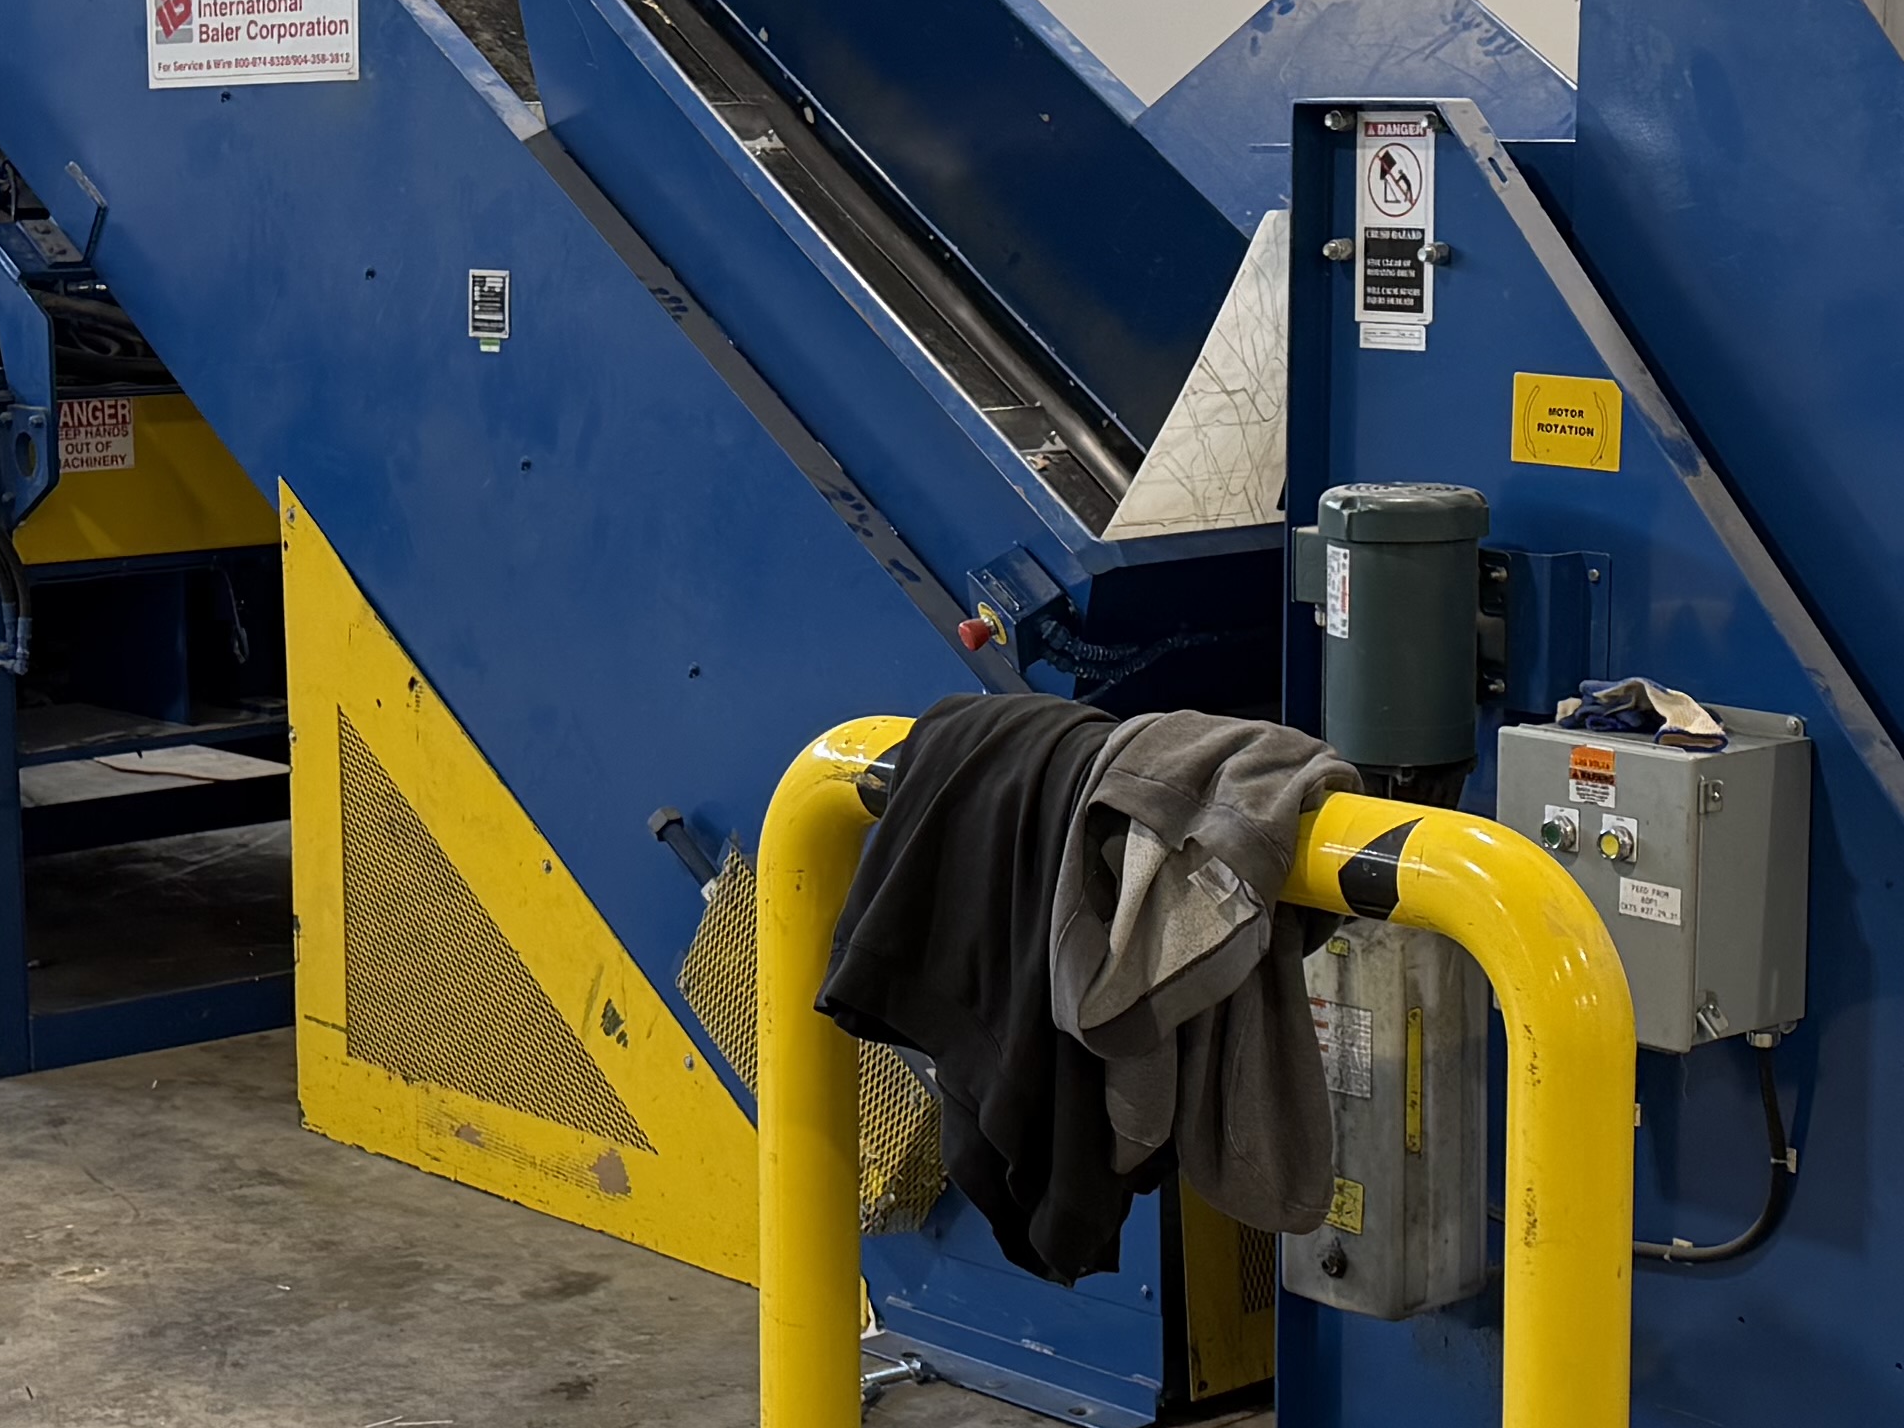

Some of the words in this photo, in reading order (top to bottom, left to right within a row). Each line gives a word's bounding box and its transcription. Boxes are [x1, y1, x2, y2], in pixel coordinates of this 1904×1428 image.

[199, 23, 240, 44] Baler
[246, 16, 349, 45] Corporation
[158, 62, 170, 72] For
[173, 61, 203, 72] Service
[207, 60, 211, 70] &
[213, 59, 232, 69] Wire
[1377, 123, 1424, 135] DANGER
[59, 399, 130, 427] ANGER
[1548, 407, 1584, 419] MOTOR
[58, 427, 82, 440] EEP
[84, 426, 129, 439] HANDS
[1537, 422, 1594, 437] ROTATION
[65, 442, 91, 455] OUT
[95, 441, 112, 453] OF
[62, 454, 127, 470] ACHINERY
[1632, 884, 1649, 894] FEED
[1652, 888, 1670, 899] FROM
